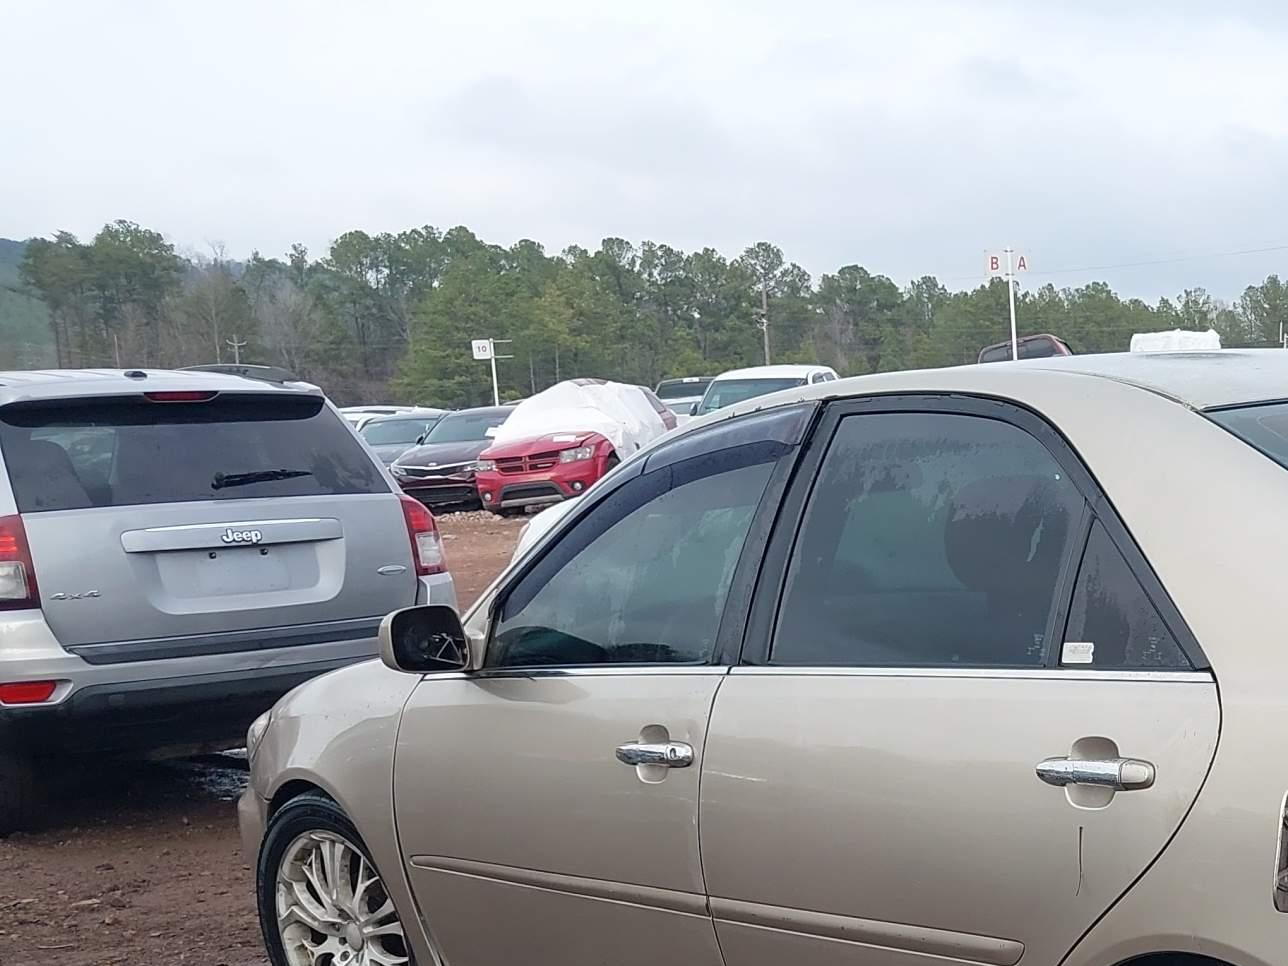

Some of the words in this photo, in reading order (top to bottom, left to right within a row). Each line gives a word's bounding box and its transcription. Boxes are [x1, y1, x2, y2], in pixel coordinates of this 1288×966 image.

[990, 256, 1000, 270] B
[1017, 256, 1027, 270] A
[477, 345, 487, 353] 10
[221, 528, 263, 544] Jeep
